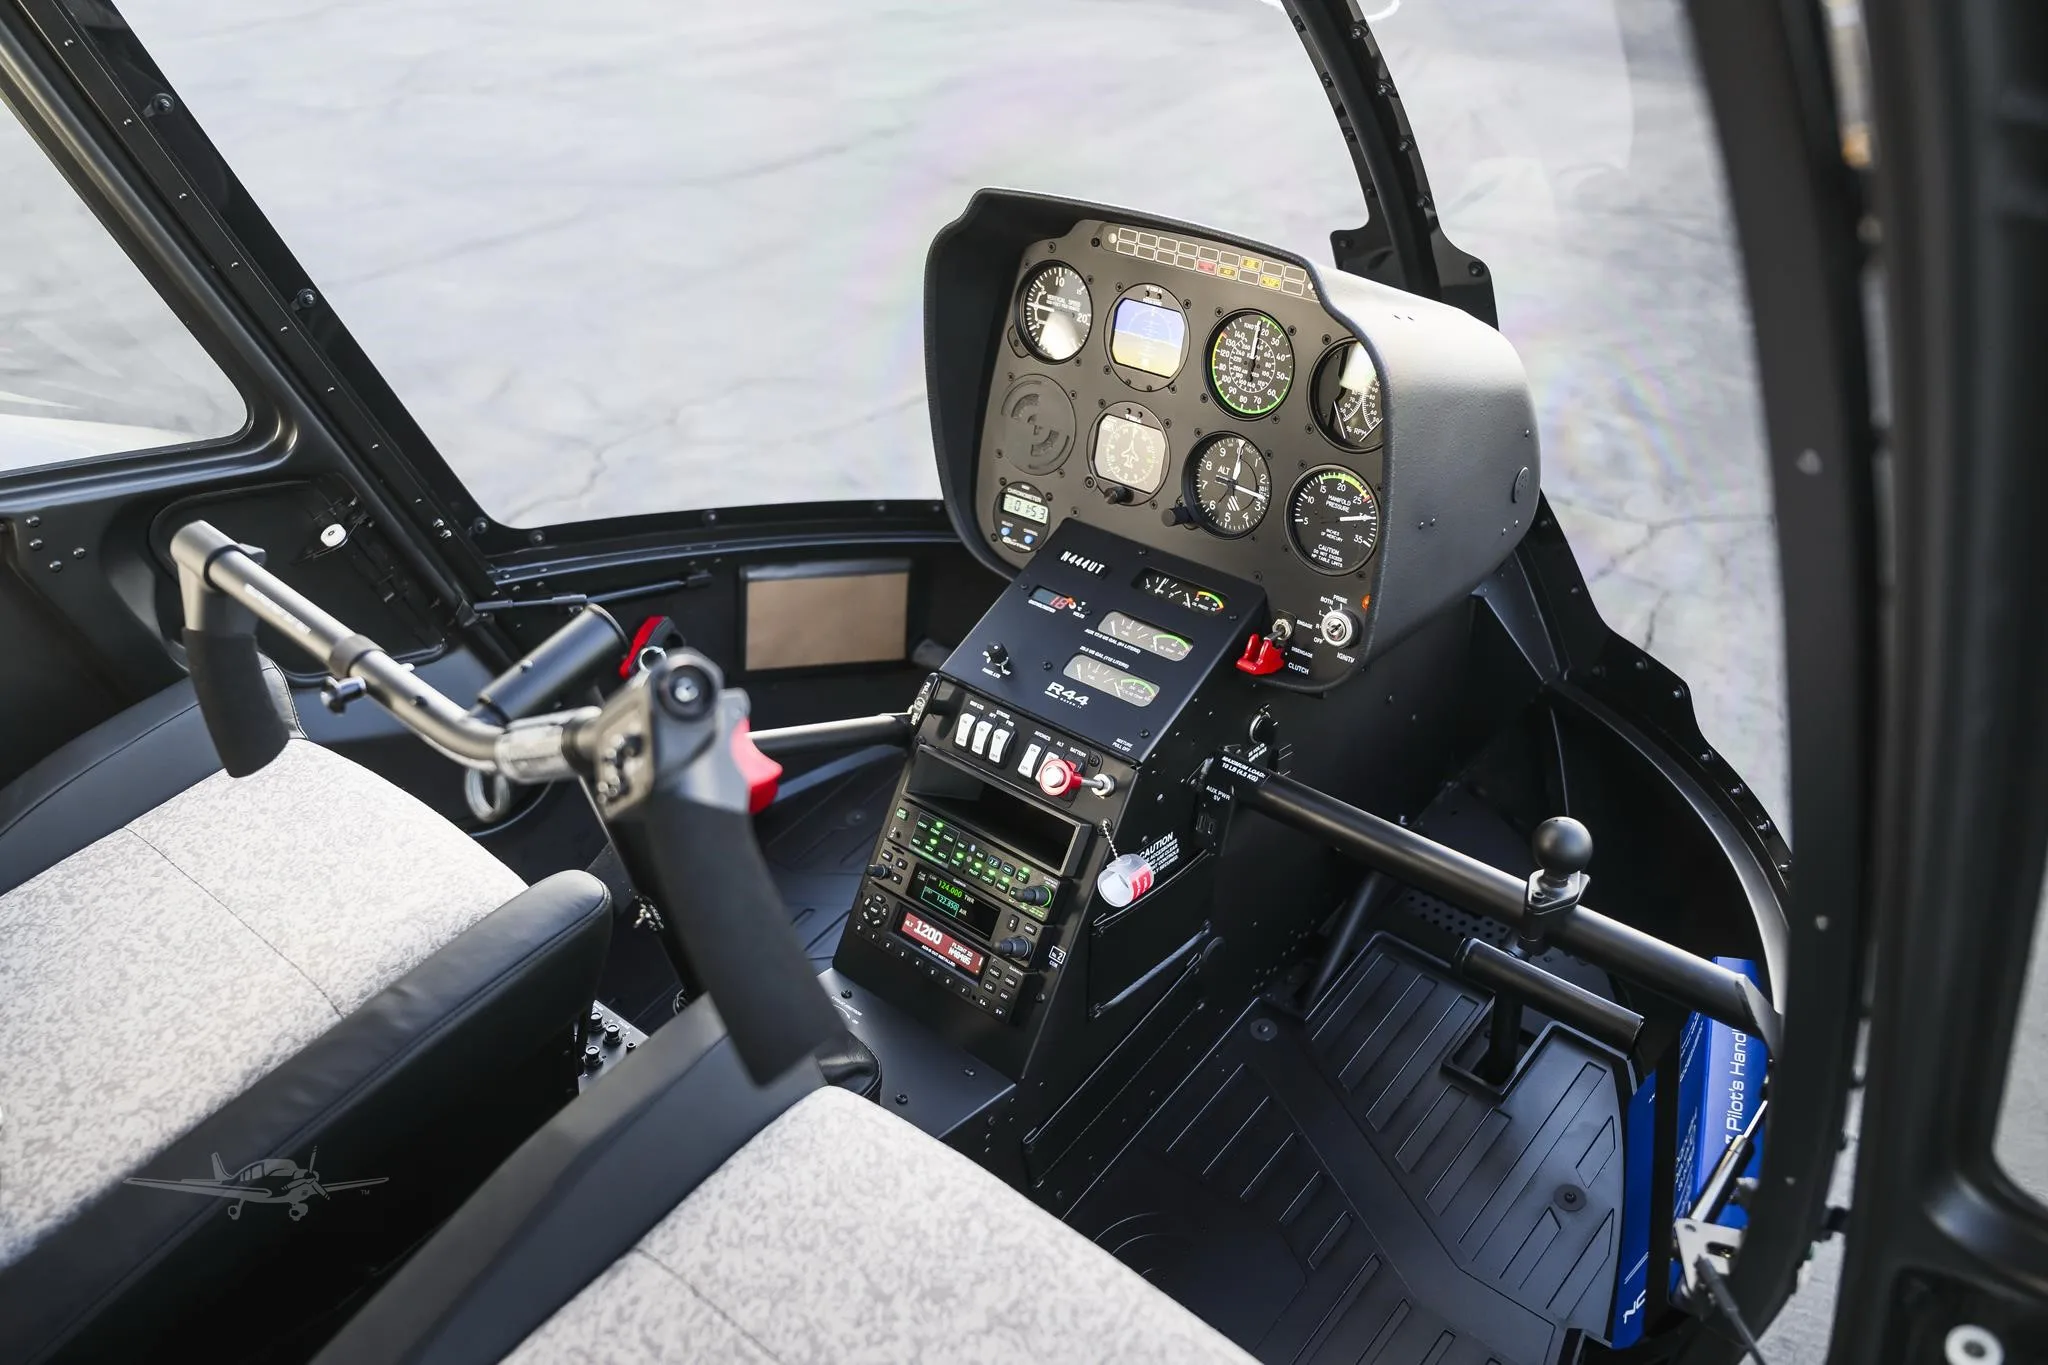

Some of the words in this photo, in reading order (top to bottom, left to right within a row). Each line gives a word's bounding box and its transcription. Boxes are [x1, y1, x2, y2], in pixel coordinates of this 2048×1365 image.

[1056, 276, 1064, 287] 10
[1076, 312, 1088, 323] 20
[1235, 331, 1245, 340] 140
[1261, 328, 1269, 336] 20
[1226, 339, 1235, 347] 130
[1271, 338, 1280, 346] 30
[1220, 349, 1230, 357] 120
[1222, 375, 1231, 384] 100
[1276, 373, 1285, 381] 50
[1228, 386, 1237, 395] 90
[1240, 396, 1247, 404] 80
[1254, 396, 1262, 404] 70
[1220, 448, 1226, 456] 9
[1206, 461, 1212, 470] 8
[1255, 458, 1258, 467] 1
[1218, 466, 1231, 475] ALT
[1260, 474, 1266, 484] 2
[1202, 480, 1208, 489] 7
[1337, 483, 1346, 492] 20
[1308, 496, 1314, 504] 10
[1328, 494, 1351, 506] MANIFOLD
[1353, 496, 1362, 505] 25
[1210, 500, 1216, 510] 6
[1255, 501, 1261, 511] 3
[1326, 500, 1350, 513] PRESSURE
[1224, 512, 1231, 522] 5
[1243, 512, 1248, 521] 4
[1303, 517, 1308, 525] 5
[1326, 533, 1343, 542] MERCURY
[1354, 535, 1363, 543] 35
[1318, 544, 1340, 555] CAUTION
[1060, 551, 1105, 574] N444UT
[1329, 554, 1342, 562] EXCEED
[1320, 596, 1333, 605] BOTH
[1333, 594, 1348, 604] PRIME
[1297, 620, 1313, 629] ENGAGE
[1291, 646, 1313, 658] DISENGAGE
[1288, 662, 1309, 675] CLUTCH
[1046, 681, 1090, 706] R44
[996, 710, 1010, 719] STROBE
[1034, 731, 1051, 741] AVIONICS
[1112, 742, 1122, 750] PULL
[1116, 738, 1133, 748] MIXTURE
[1070, 747, 1086, 758] BATTERY
[1222, 756, 1249, 770] MAXIMUM
[1248, 768, 1266, 779] LOAD:
[1247, 774, 1259, 783] KG)
[1206, 785, 1218, 794] AUX
[1218, 790, 1230, 800] PWR
[1140, 832, 1173, 858] CAUTION
[1150, 838, 1178, 861] ACCESSORIES
[1158, 848, 1179, 865] CONTROLS
[938, 880, 963, 898] 124.000
[964, 894, 975, 904] TWR
[937, 895, 959, 911] 122.850
[914, 920, 943, 945] 1200
[952, 942, 967, 954] FLIGHT
[938, 954, 956, 967] INSTALLED
[1049, 960, 1058, 968] COM
[1726, 1081, 1744, 1132] Pilot's
